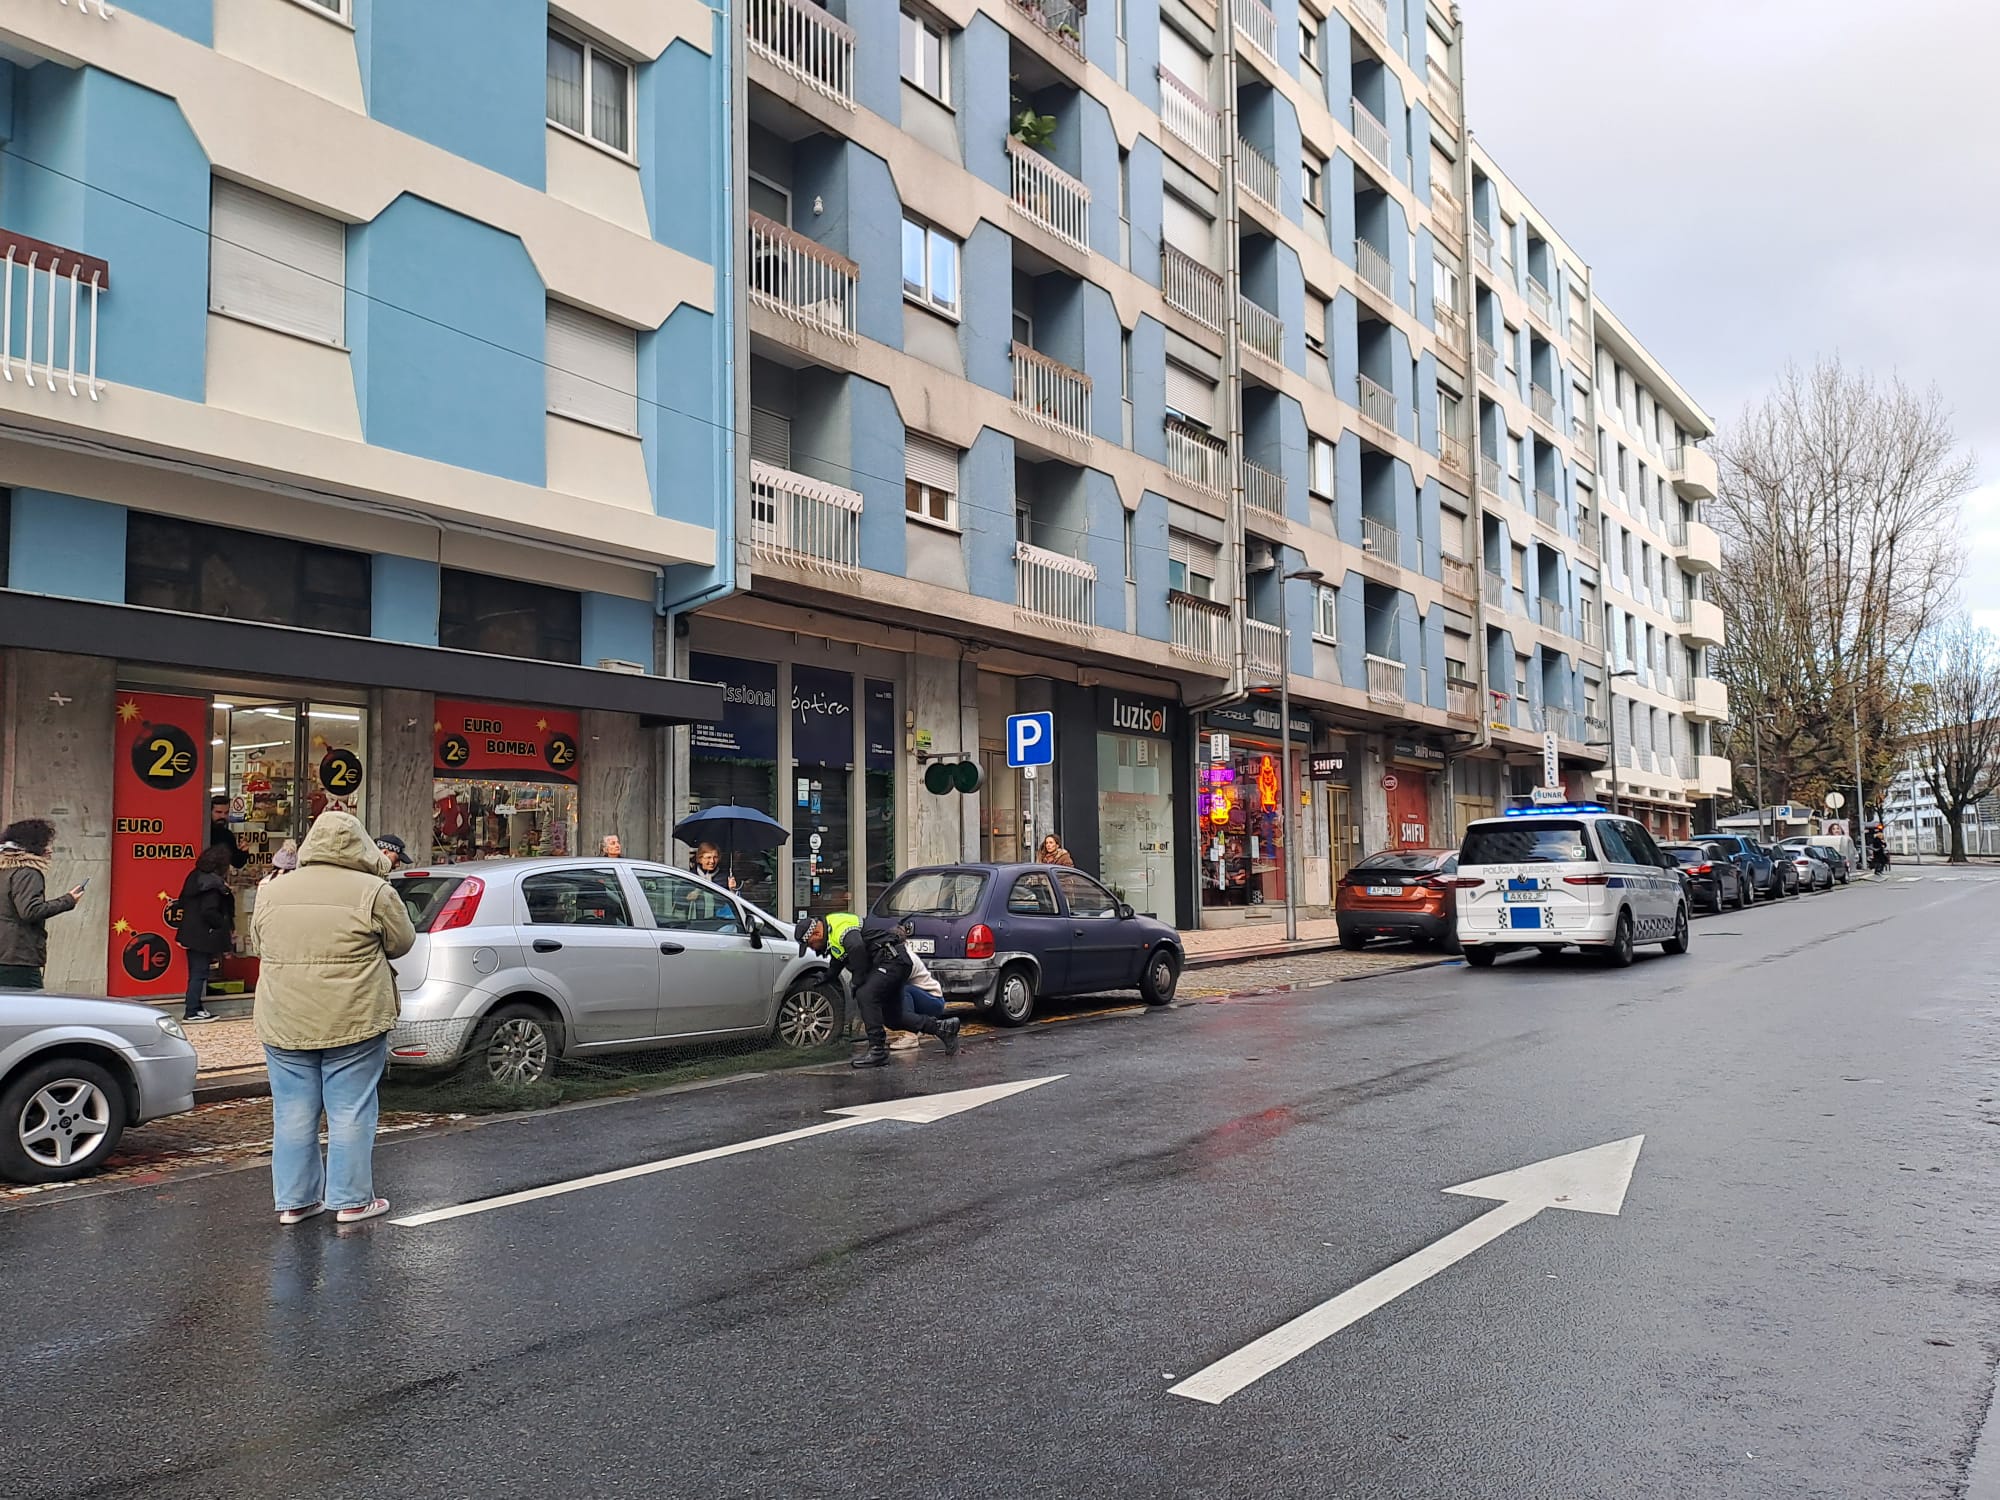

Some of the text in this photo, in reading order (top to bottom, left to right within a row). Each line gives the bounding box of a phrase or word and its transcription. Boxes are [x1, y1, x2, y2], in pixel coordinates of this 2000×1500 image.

[718, 681, 776, 707] issional
[1113, 697, 1167, 733] Luzisol
[1253, 709, 1311, 732] SHIFU AMEN
[464, 718, 502, 734] EURO
[447, 741, 468, 760] 2€
[486, 740, 537, 757] BOMBA
[1016, 719, 1042, 762] P
[148, 739, 191, 776] 2€
[552, 741, 575, 763] 2€
[330, 760, 358, 786] 2€
[1313, 759, 1343, 771] SHIFU
[116, 818, 164, 834] EURO
[1402, 823, 1425, 842] SHIFU
[133, 844, 196, 860] BOMBA
[248, 853, 273, 865] OMB
[137, 944, 167, 971] 1€
